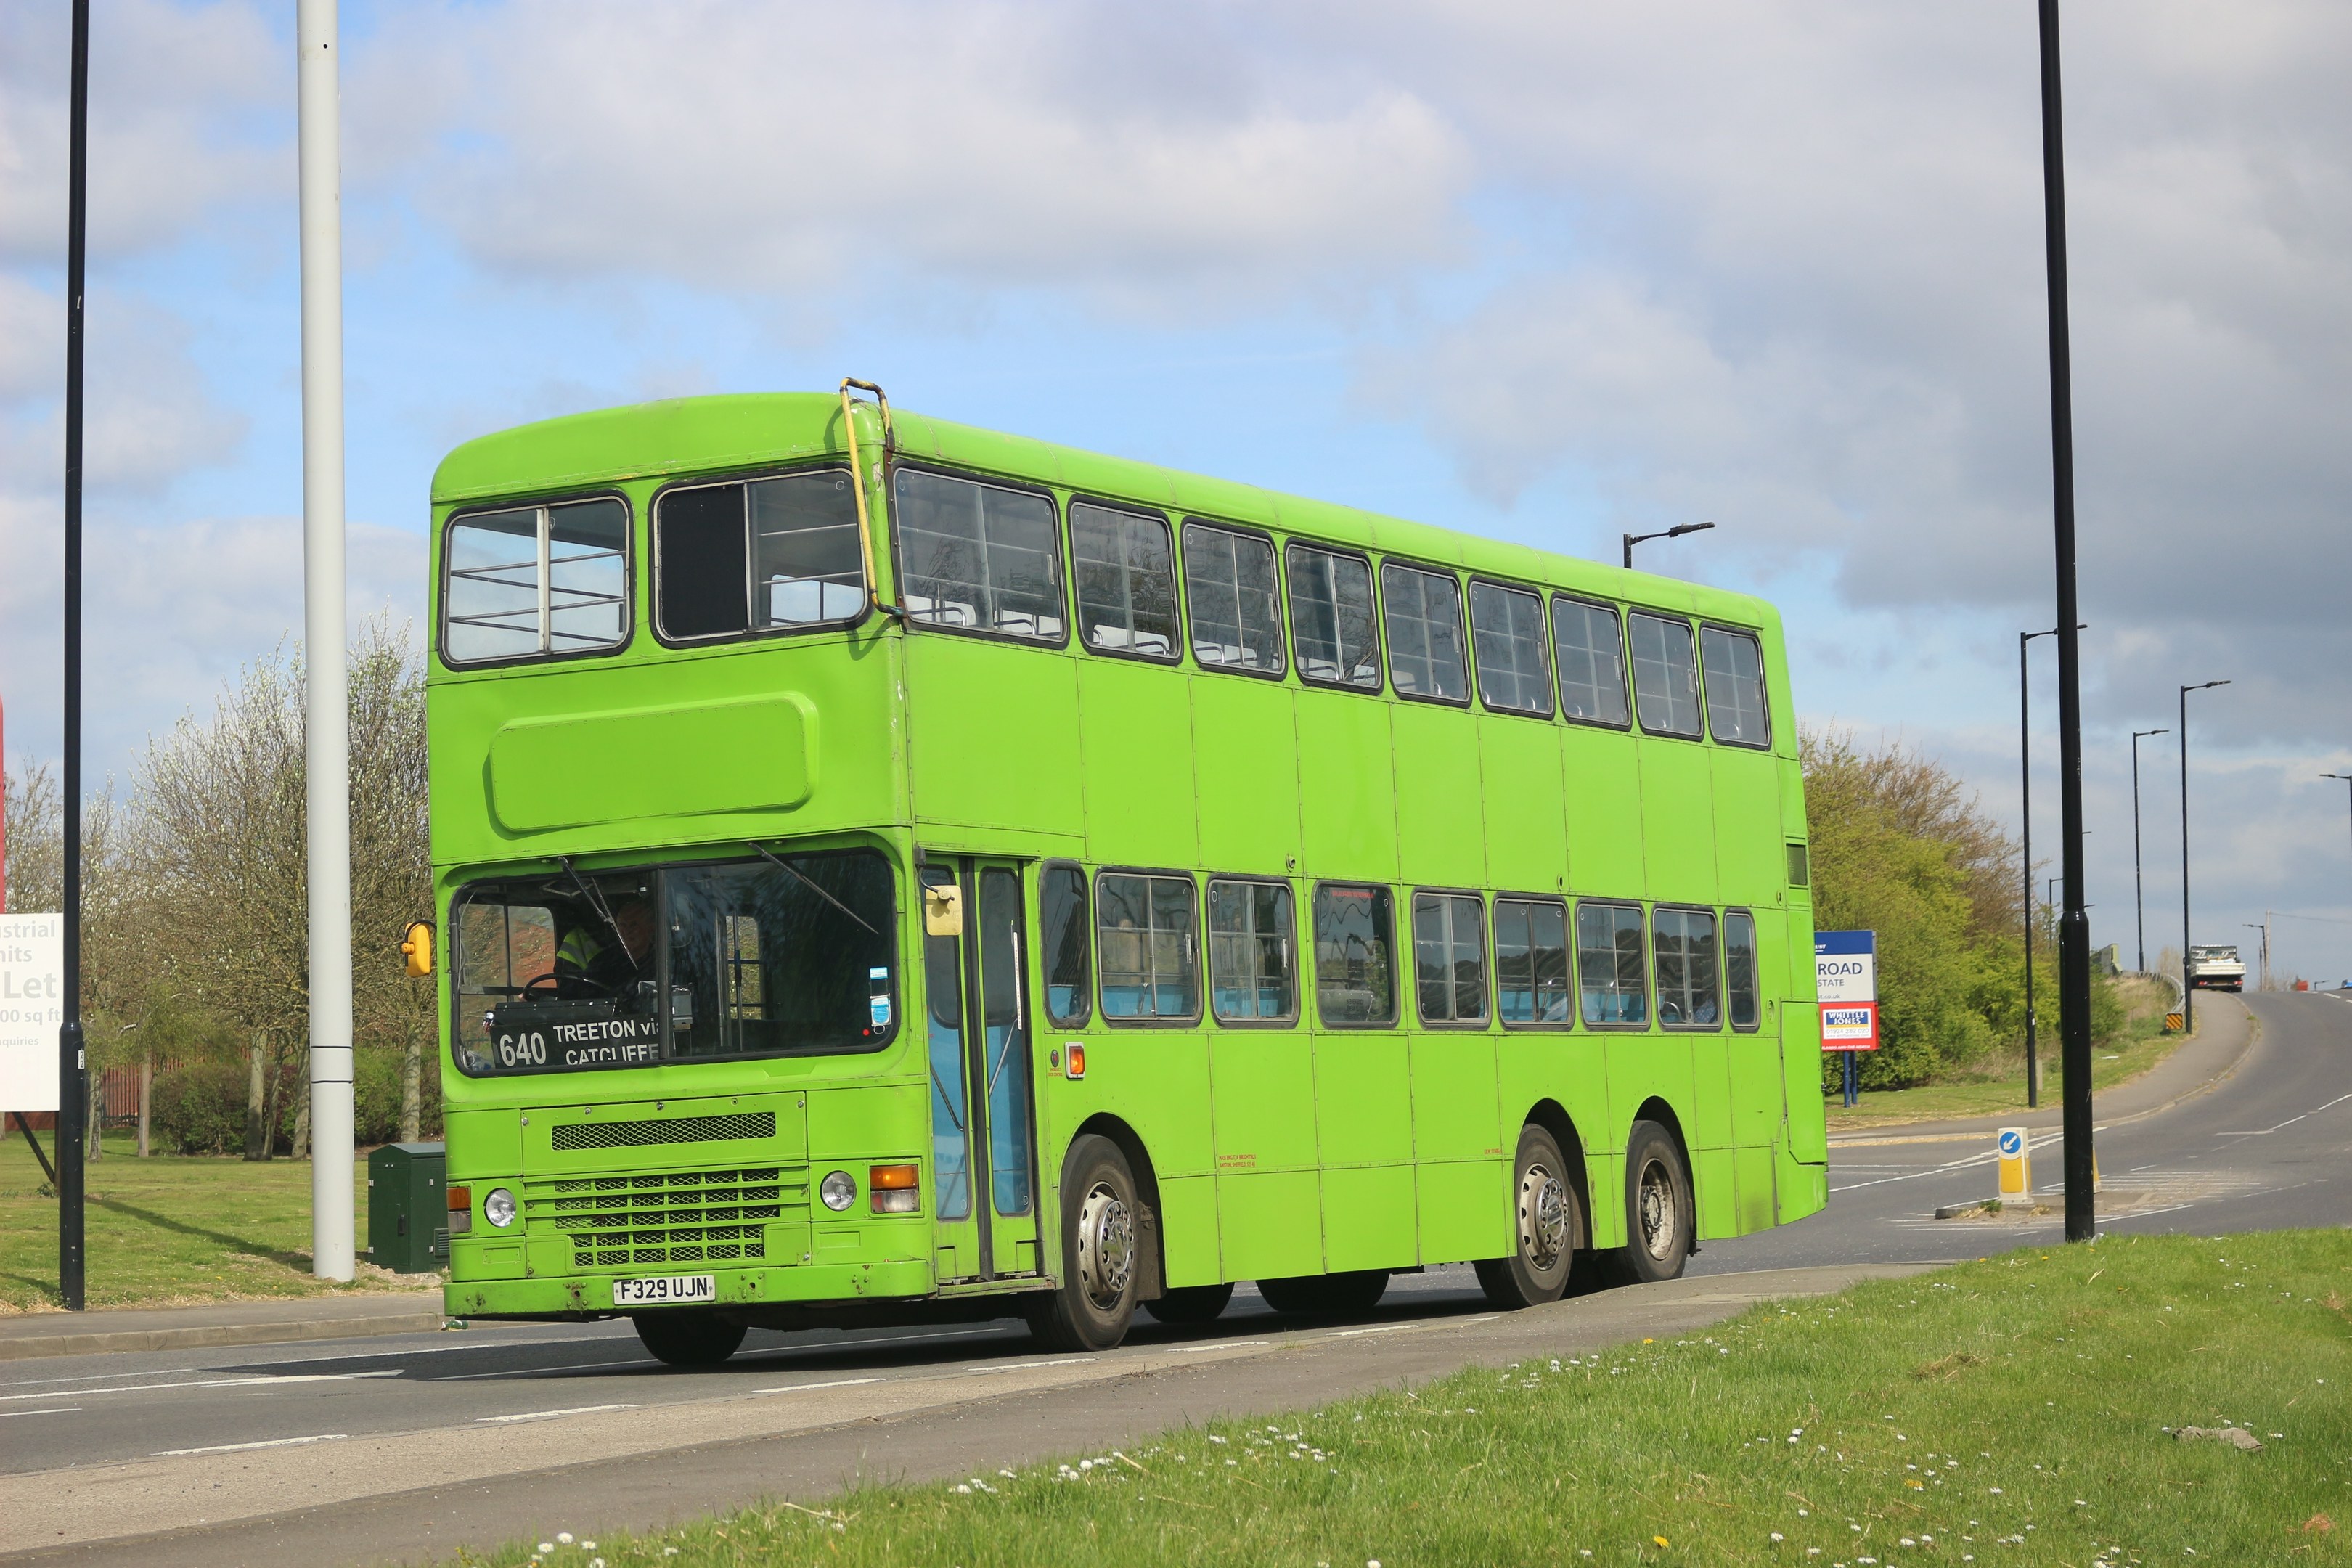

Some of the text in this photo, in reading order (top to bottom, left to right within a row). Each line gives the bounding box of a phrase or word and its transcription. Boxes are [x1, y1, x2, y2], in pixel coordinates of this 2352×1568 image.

[0, 920, 55, 938] strial
[1818, 963, 1863, 976] ROAD
[4, 971, 57, 999] Let
[24, 1011, 43, 1026] sq
[47, 1008, 60, 1022] ft
[552, 1018, 659, 1042] TREETON vi
[0, 1037, 39, 1048] quiries
[499, 1032, 547, 1067] 640
[621, 1277, 708, 1299] F329 UJN
